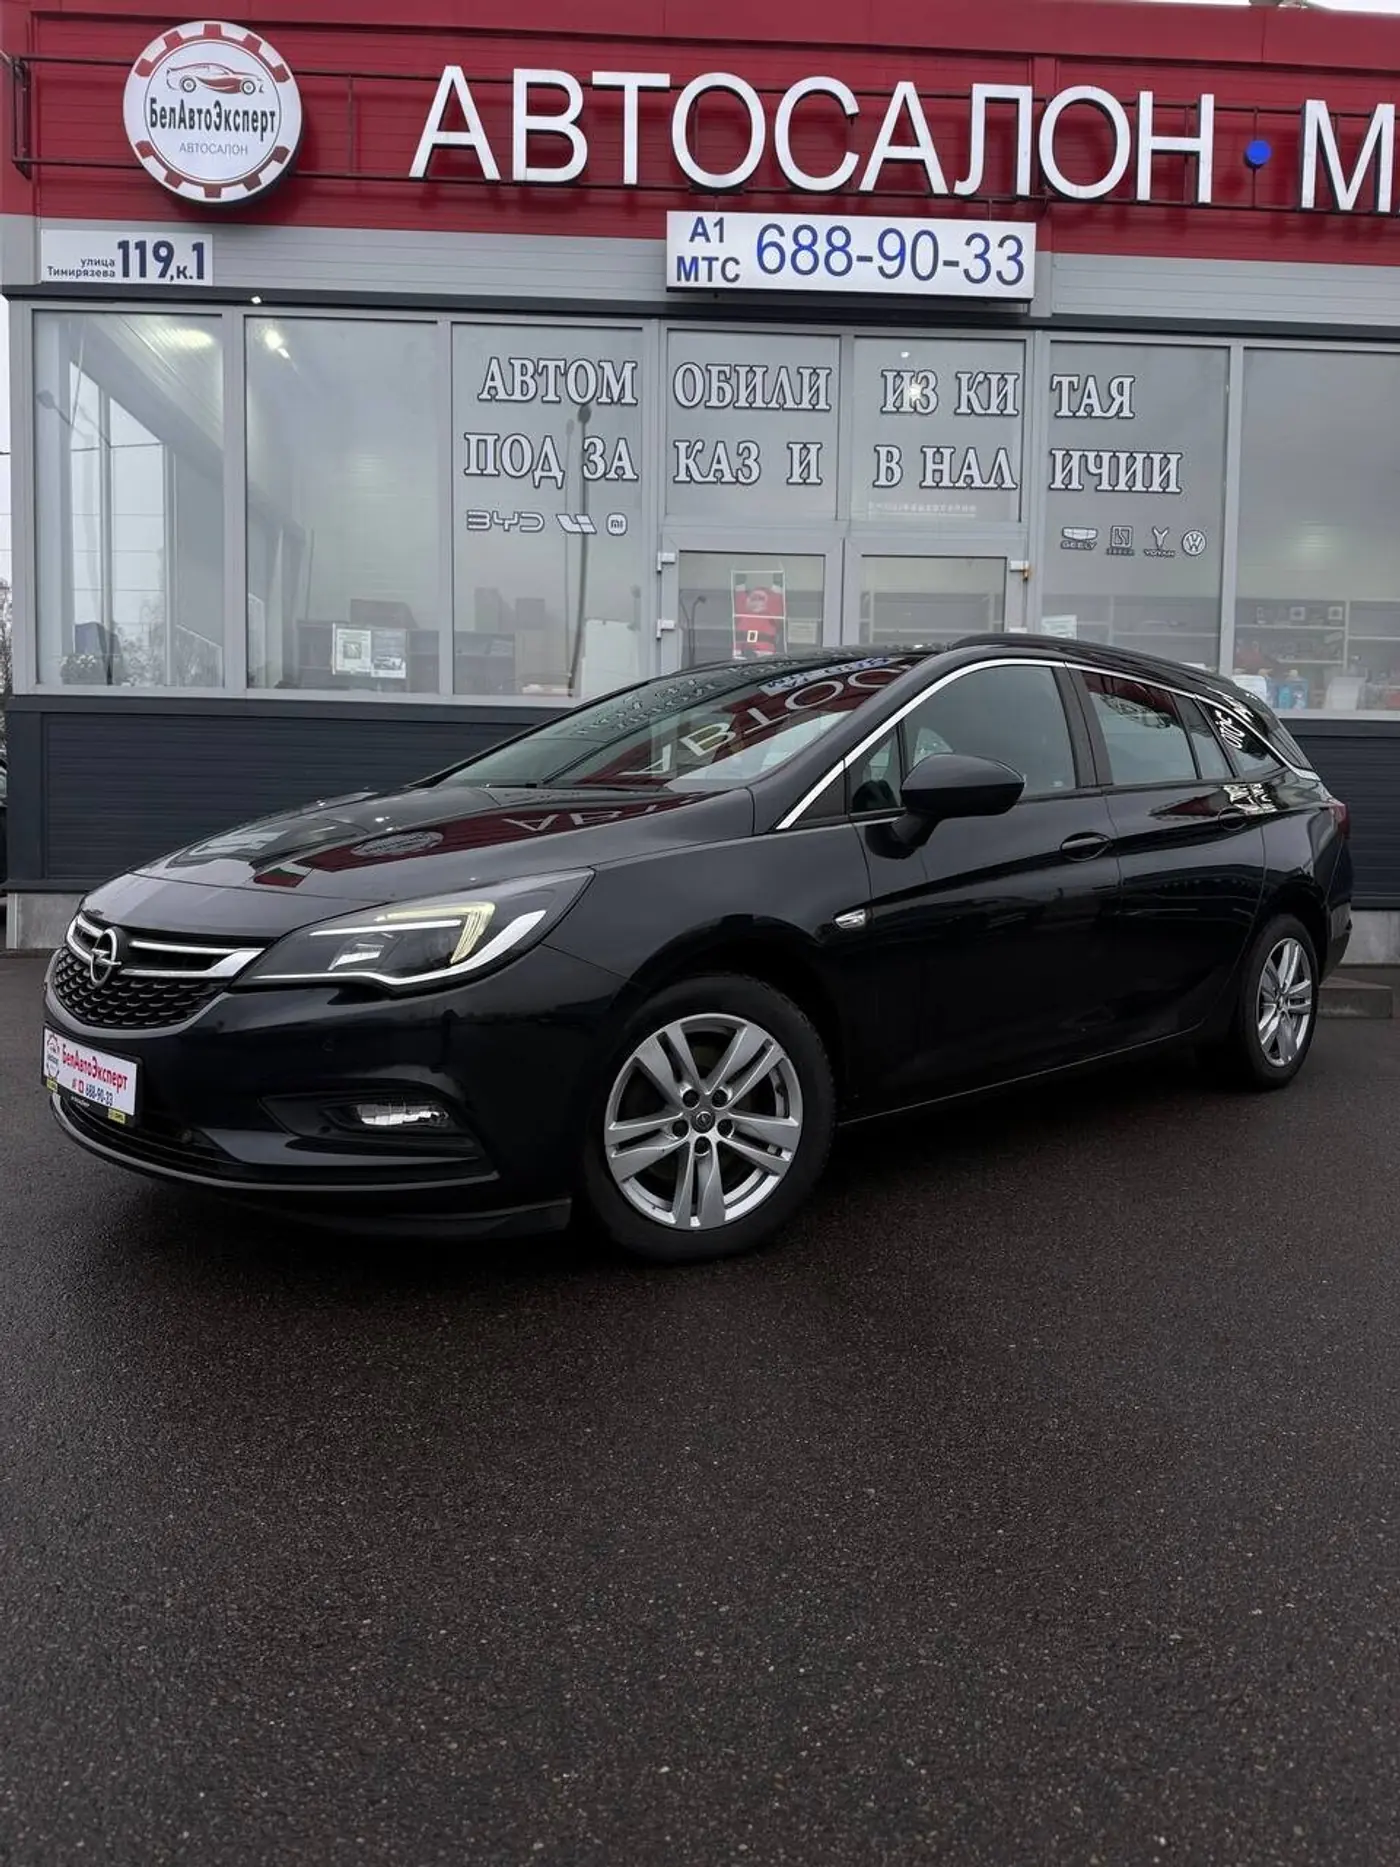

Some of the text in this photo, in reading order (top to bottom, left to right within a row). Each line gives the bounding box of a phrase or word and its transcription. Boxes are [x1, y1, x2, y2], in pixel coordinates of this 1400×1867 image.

[150, 97, 276, 142] БелАвтоЭксперт
[409, 64, 1215, 204] АВТОСАЛОН
[179, 142, 248, 156] АВТОСАЛОН
[689, 216, 725, 243] A1
[47, 266, 115, 278] Тимирязева
[80, 257, 115, 268] улица
[676, 256, 741, 283] МТС
[756, 223, 1025, 286] 688-90-33
[478, 357, 1136, 419] АВТОМ ОБИЛИ ИЗ КИ ТАЯ
[464, 432, 1183, 494] ПОД ЗА КАЗ И В НАЛ ИЧИИ
[466, 509, 545, 533] BYD
[62, 1043, 128, 1094] БелАвтоЭксперт
